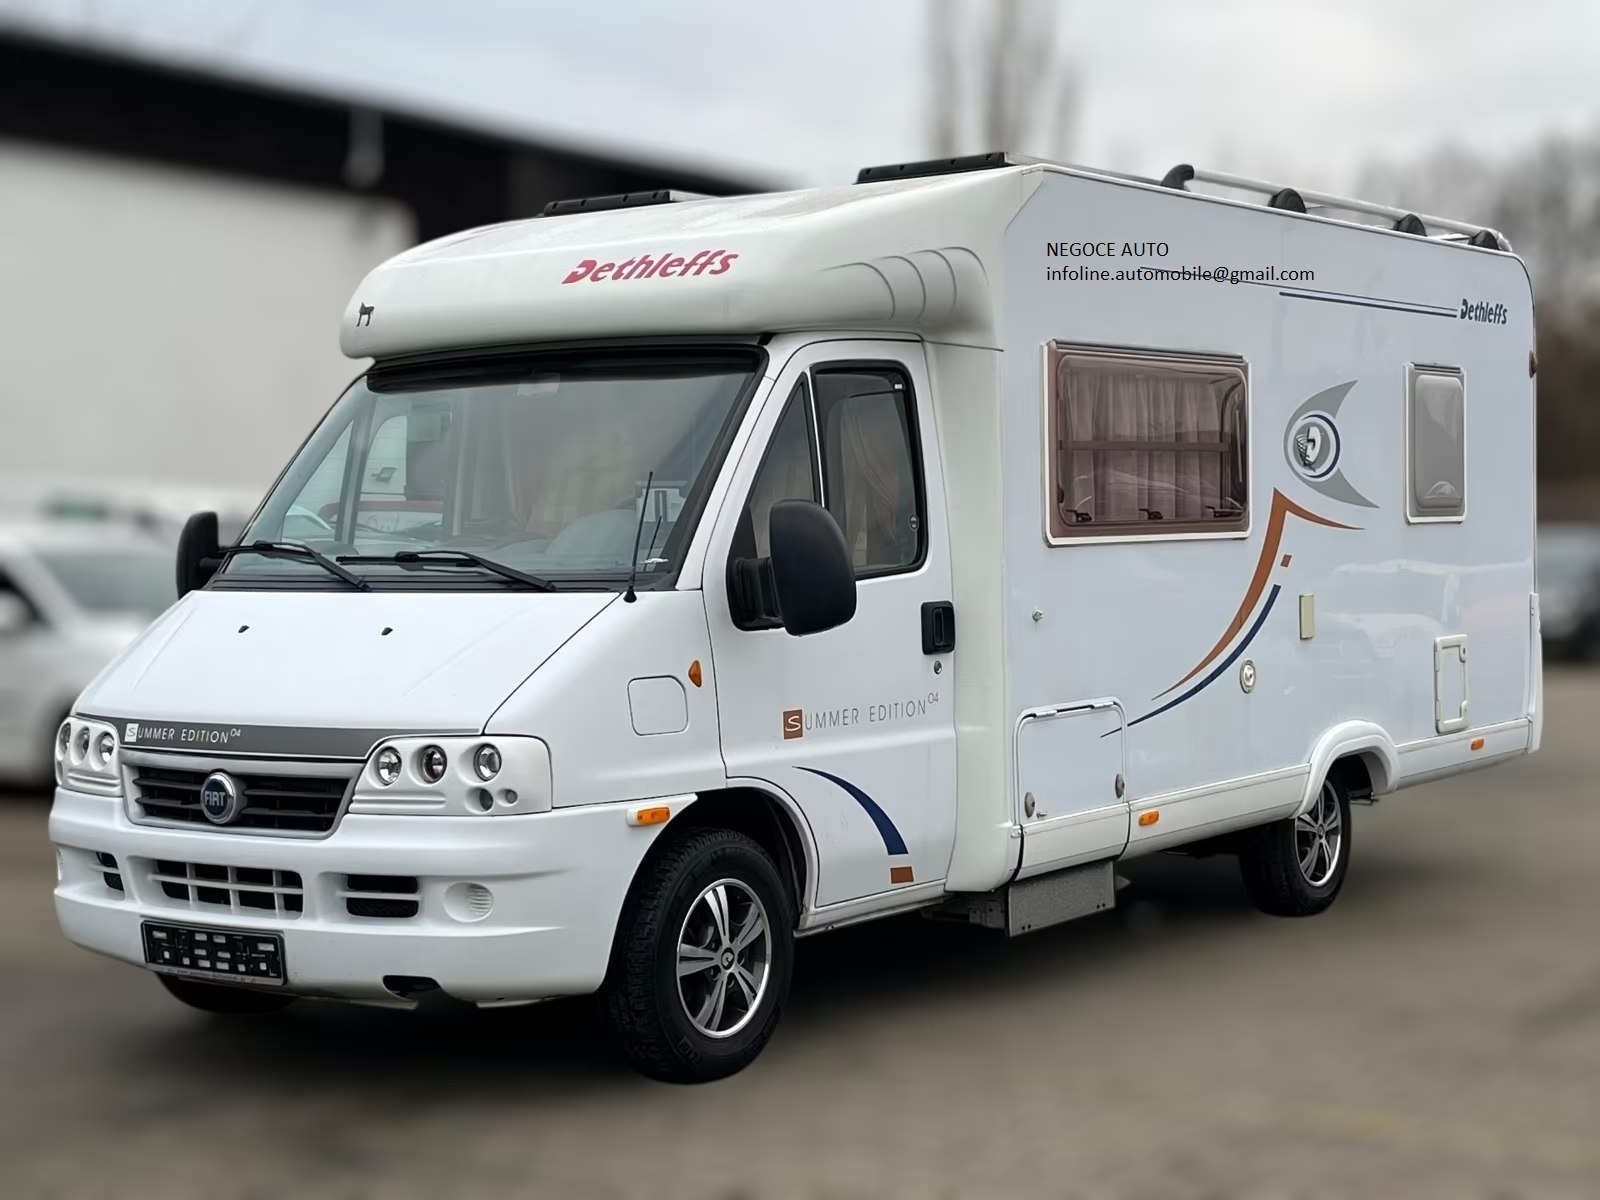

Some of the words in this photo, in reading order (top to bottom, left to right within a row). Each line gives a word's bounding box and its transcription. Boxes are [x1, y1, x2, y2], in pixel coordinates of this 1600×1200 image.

[561, 249, 739, 285] Dethleffs
[1460, 298, 1508, 325] Dethleffs
[783, 707, 860, 737] SUMMER
[869, 699, 926, 723] EDITION
[125, 723, 176, 742] SUMMER
[180, 728, 229, 744] EDITION
[204, 790, 226, 807] FIAT
